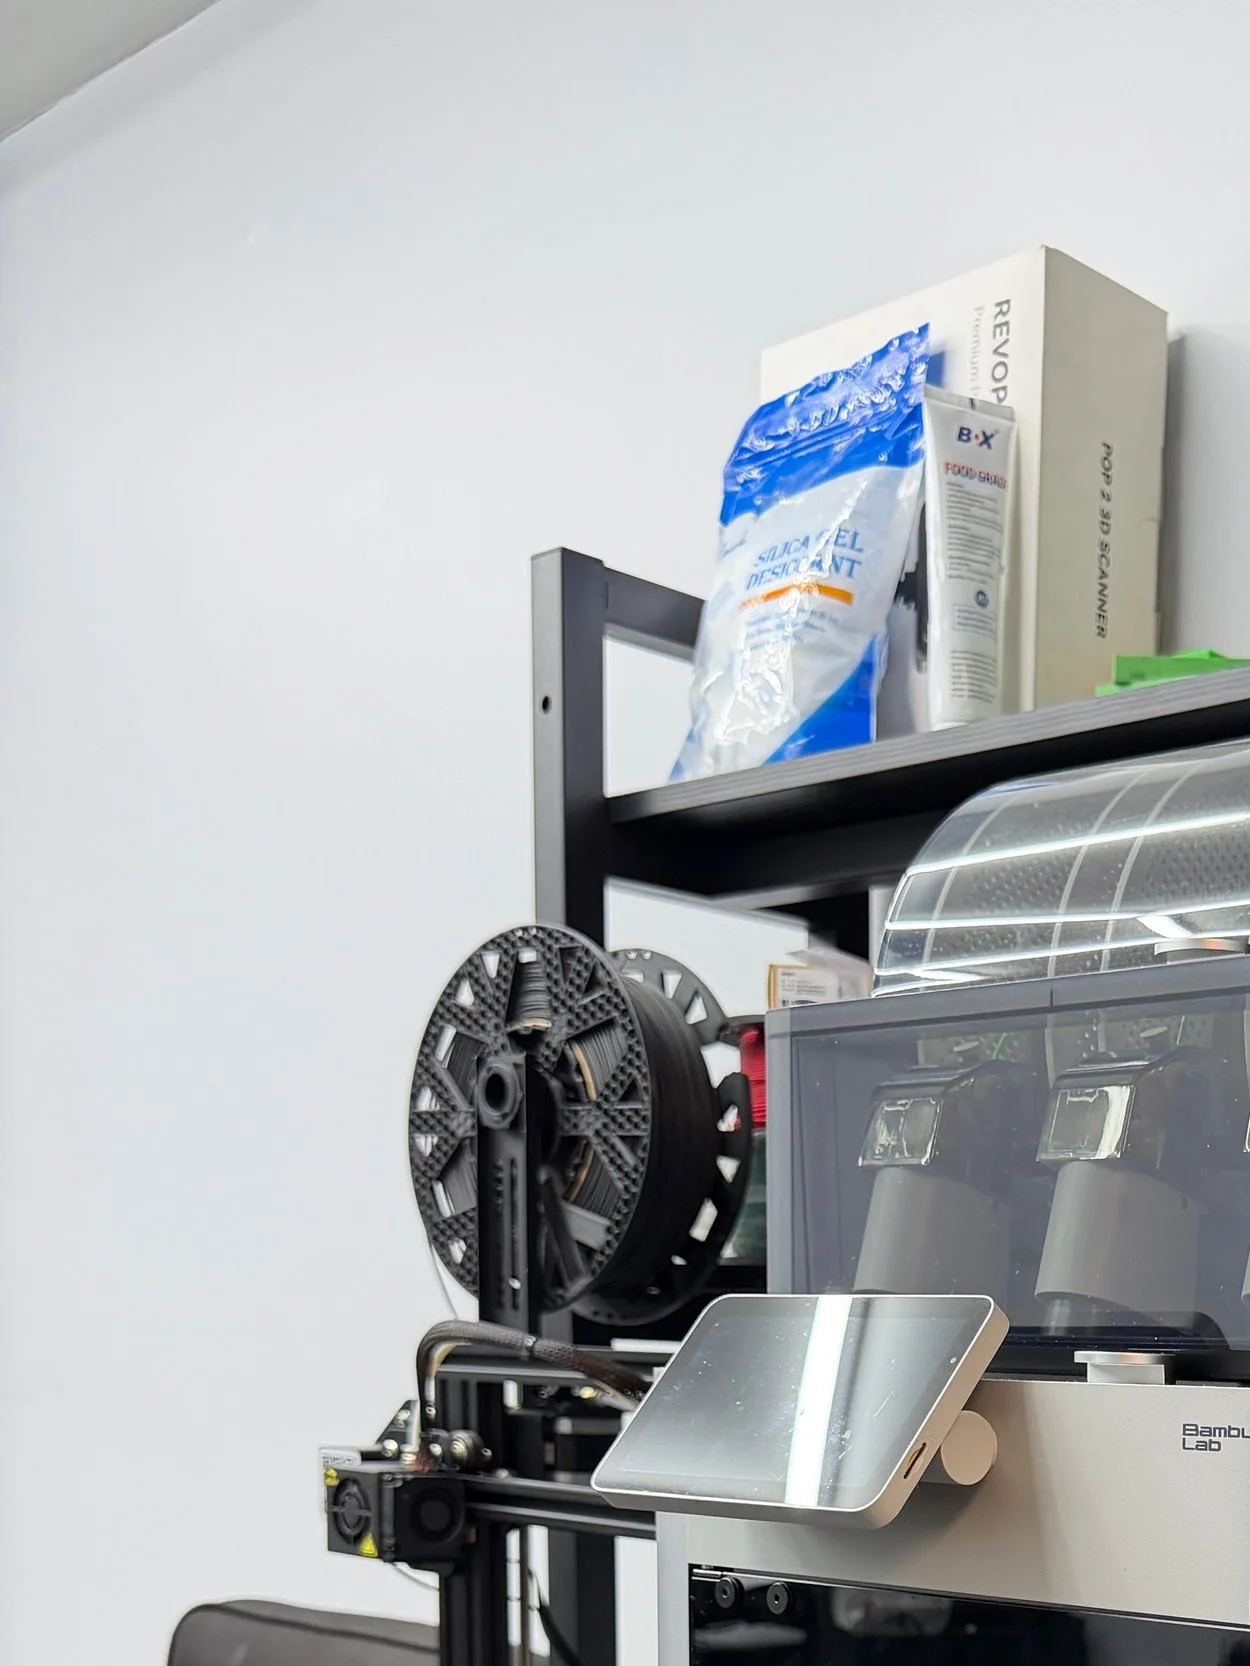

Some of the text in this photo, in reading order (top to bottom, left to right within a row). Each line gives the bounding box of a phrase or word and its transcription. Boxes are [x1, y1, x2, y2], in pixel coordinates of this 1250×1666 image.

[1094, 441, 1113, 639] POP 2 3D SCANNER
[1182, 1437, 1222, 1452] Lab
